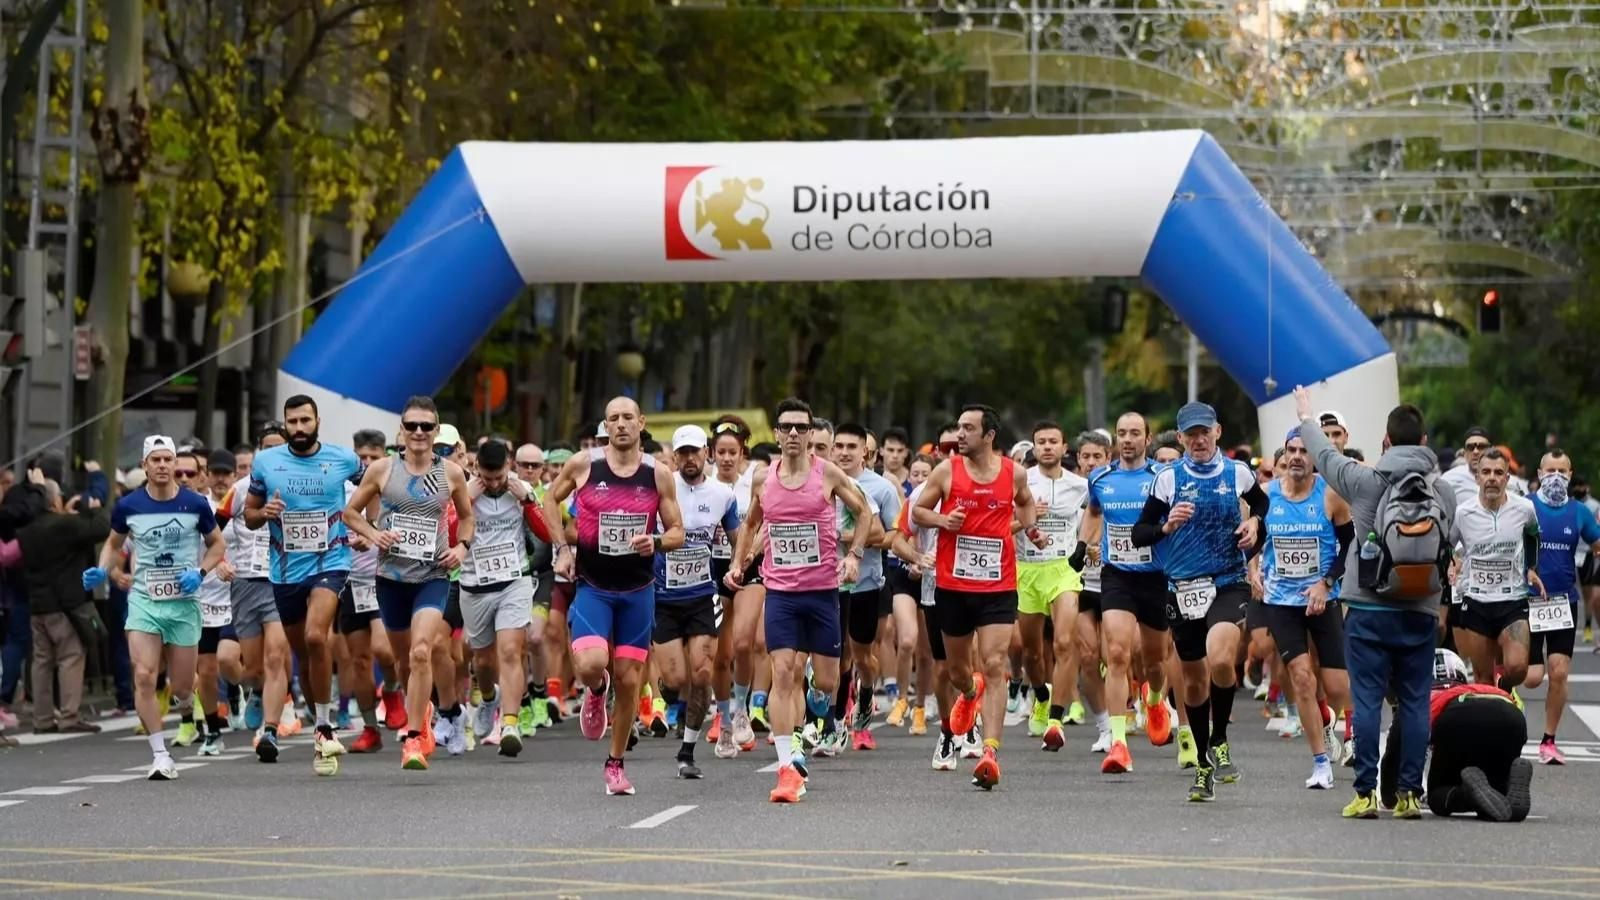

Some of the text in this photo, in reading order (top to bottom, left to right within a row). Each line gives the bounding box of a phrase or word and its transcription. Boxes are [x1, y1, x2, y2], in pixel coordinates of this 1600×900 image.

[793, 182, 990, 220] Diputación
[791, 221, 992, 251] de Córdoba
[291, 525, 319, 540] 518
[609, 528, 636, 542] 511
[1268, 523, 1323, 533] TROTASIERRA
[779, 539, 809, 554] 316
[485, 556, 511, 573] 131
[969, 552, 989, 569] 36
[1282, 551, 1310, 565] 669
[675, 560, 703, 577] 676
[1478, 571, 1504, 586] 553
[154, 582, 182, 597] 605
[1537, 607, 1562, 621] 610
